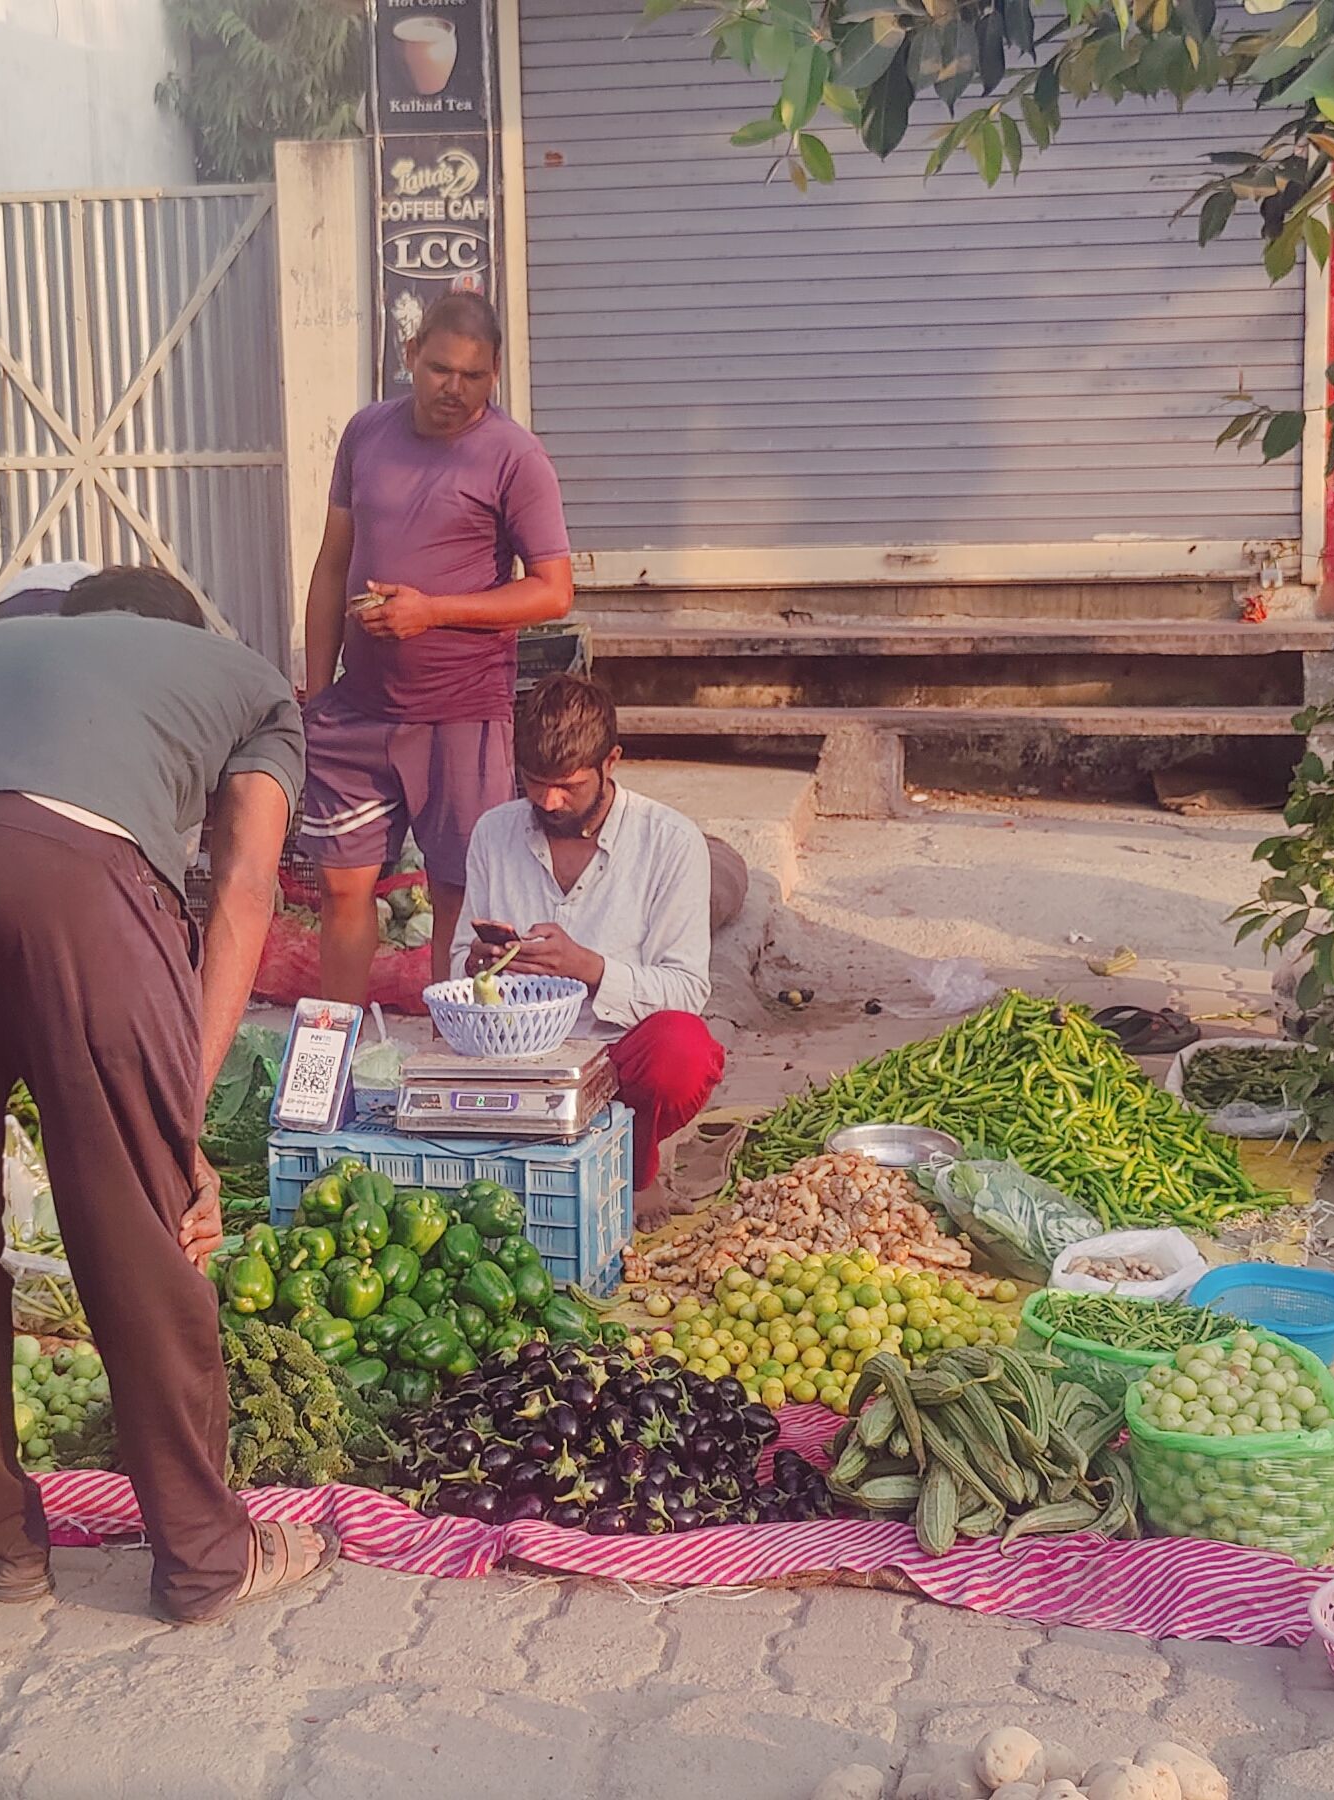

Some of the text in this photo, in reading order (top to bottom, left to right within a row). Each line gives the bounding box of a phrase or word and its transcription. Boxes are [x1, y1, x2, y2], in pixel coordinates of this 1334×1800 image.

[389, 97, 472, 113] Kulhad Tea
[381, 200, 445, 220] COFFEE
[395, 239, 478, 269] LCC
